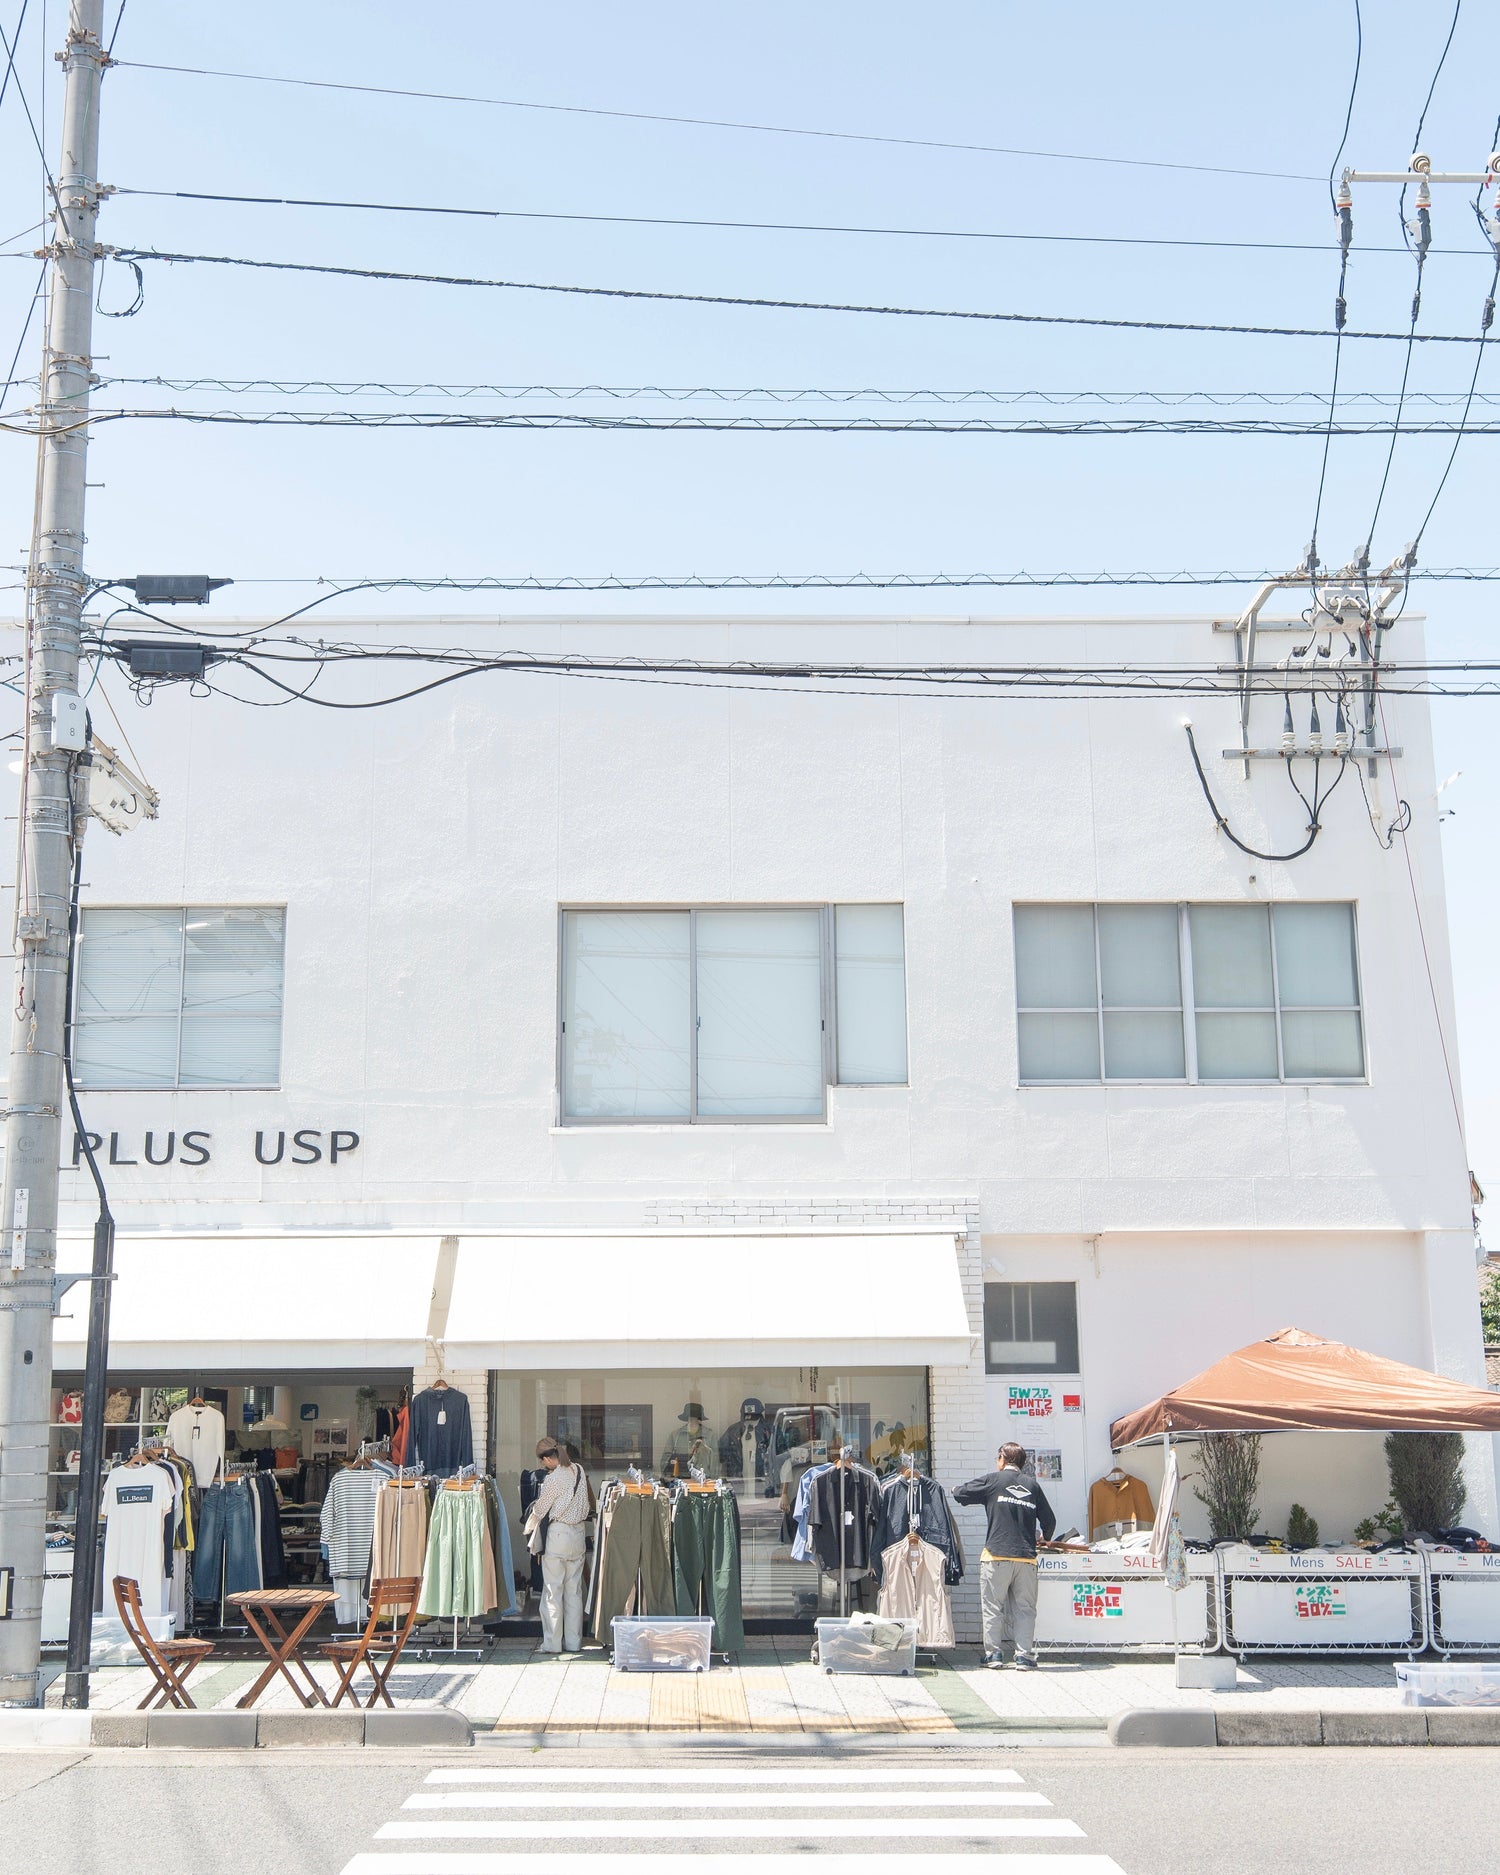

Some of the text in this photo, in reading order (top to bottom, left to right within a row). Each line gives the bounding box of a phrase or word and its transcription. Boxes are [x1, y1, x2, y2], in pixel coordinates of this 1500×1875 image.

[72, 1130, 360, 1165] PLUS USP
[1290, 1556, 1373, 1568] Mens SALE
[1086, 1595, 1120, 1607] SALE
[1074, 1603, 1104, 1617] 50%
[1298, 1602, 1332, 1617] 50%
